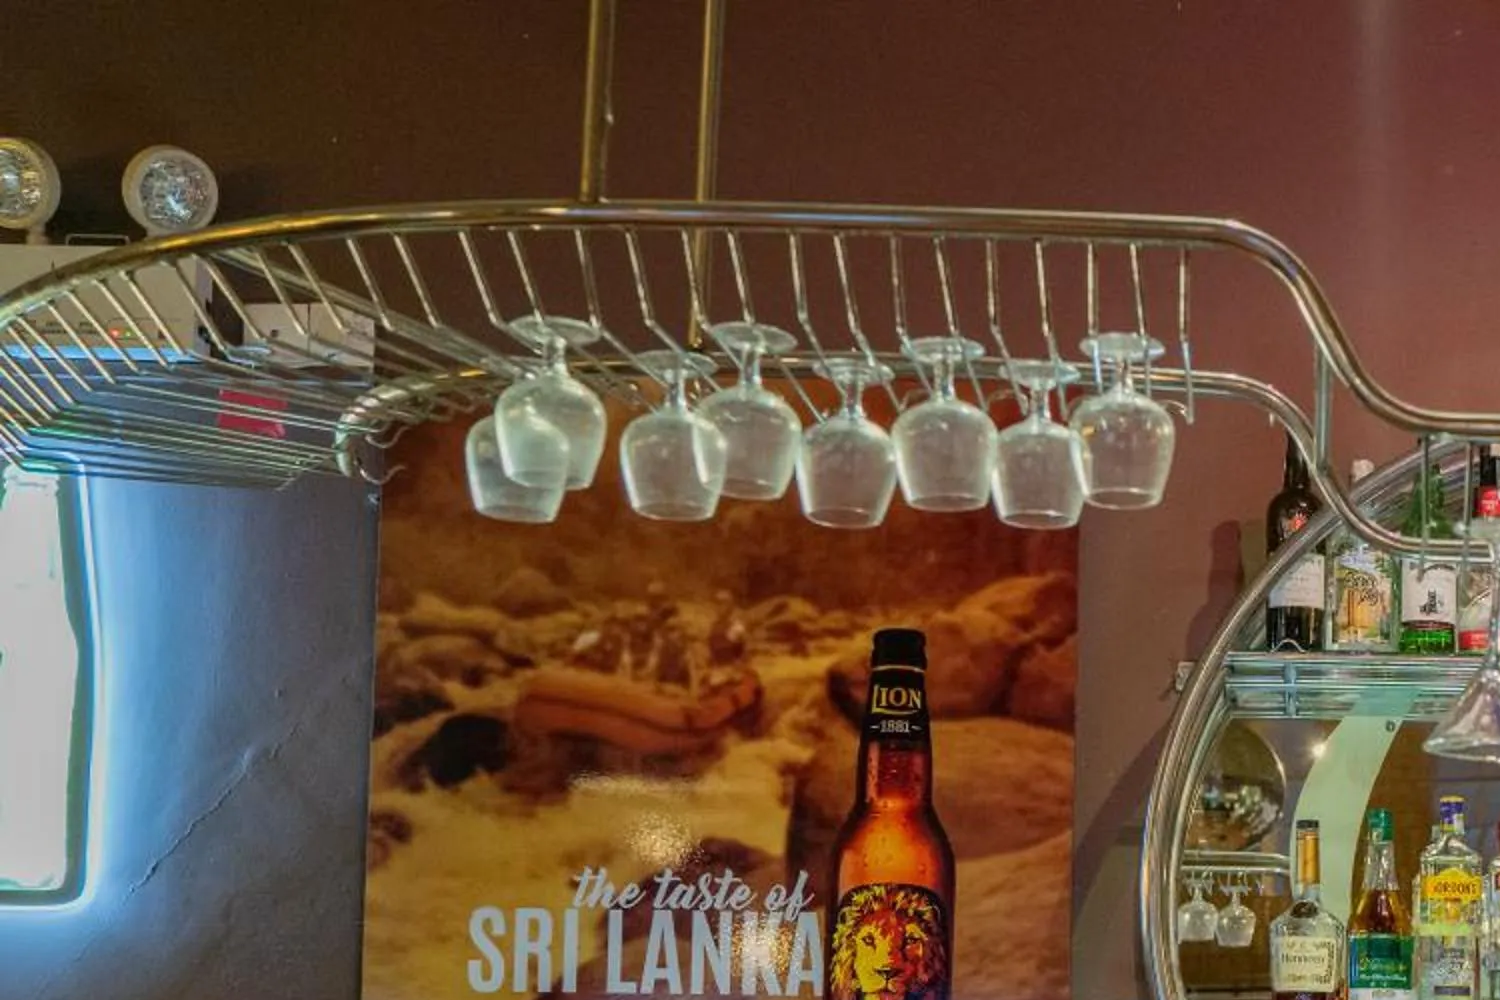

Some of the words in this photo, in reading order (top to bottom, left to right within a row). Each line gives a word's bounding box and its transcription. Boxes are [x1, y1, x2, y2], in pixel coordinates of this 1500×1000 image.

[871, 684, 922, 715] LION
[572, 866, 646, 909] the
[653, 868, 756, 911] taste
[764, 870, 815, 921] of
[467, 905, 579, 993] SRI
[605, 908, 825, 997] LANKA
